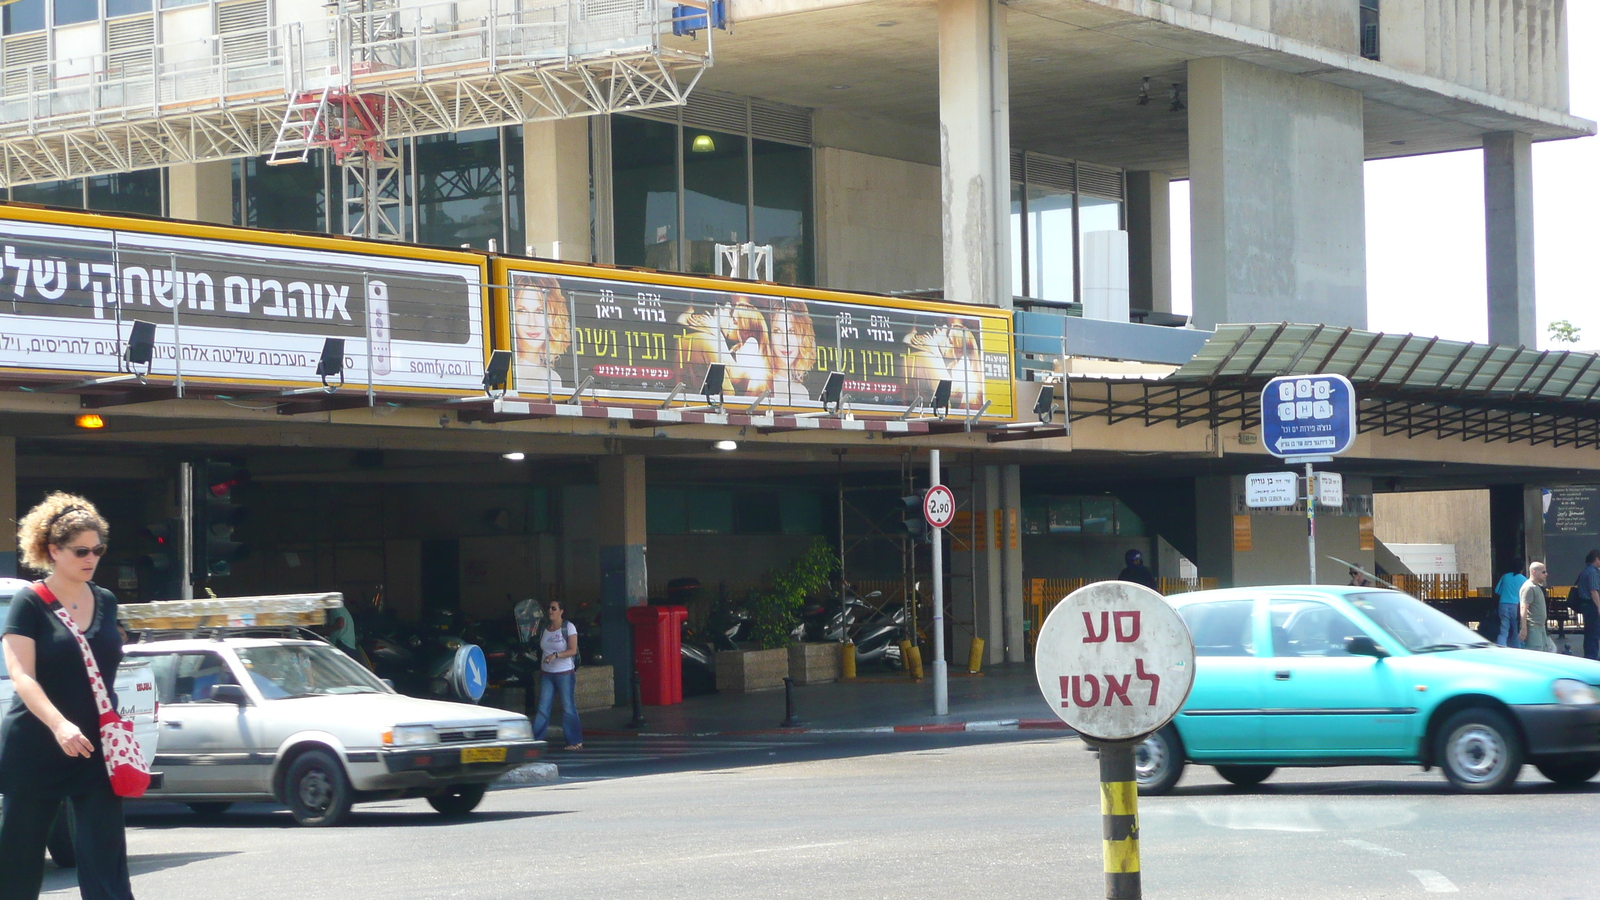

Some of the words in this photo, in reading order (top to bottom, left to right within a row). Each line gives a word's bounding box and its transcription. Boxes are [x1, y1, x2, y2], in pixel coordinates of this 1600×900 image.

[79, 262, 214, 319] משחקי
[225, 275, 352, 321] אוהבים
[600, 289, 614, 303] מג
[638, 292, 661, 307] אדם
[596, 304, 622, 319] ריאן
[632, 307, 666, 322] ברודי
[840, 312, 851, 324] מג
[871, 315, 890, 328] אדם
[867, 329, 894, 342] ברודי
[213, 348, 254, 364] שליטה
[625, 331, 666, 366] תבין
[673, 328, 694, 369] לך
[259, 352, 306, 367] מערכות
[861, 349, 894, 381] תבין
[900, 348, 916, 384] לך
[410, 359, 472, 378] somfy.co.il
[599, 365, 637, 377] בקולנוע
[641, 368, 669, 378] עכשיו
[985, 364, 1008, 378] זהב
[844, 381, 871, 390] בקולנו
[874, 384, 896, 392] עכשיו
[931, 500, 949, 513] 2.90
[1082, 610, 1140, 643] סע
[1059, 659, 1160, 708] לאט!
